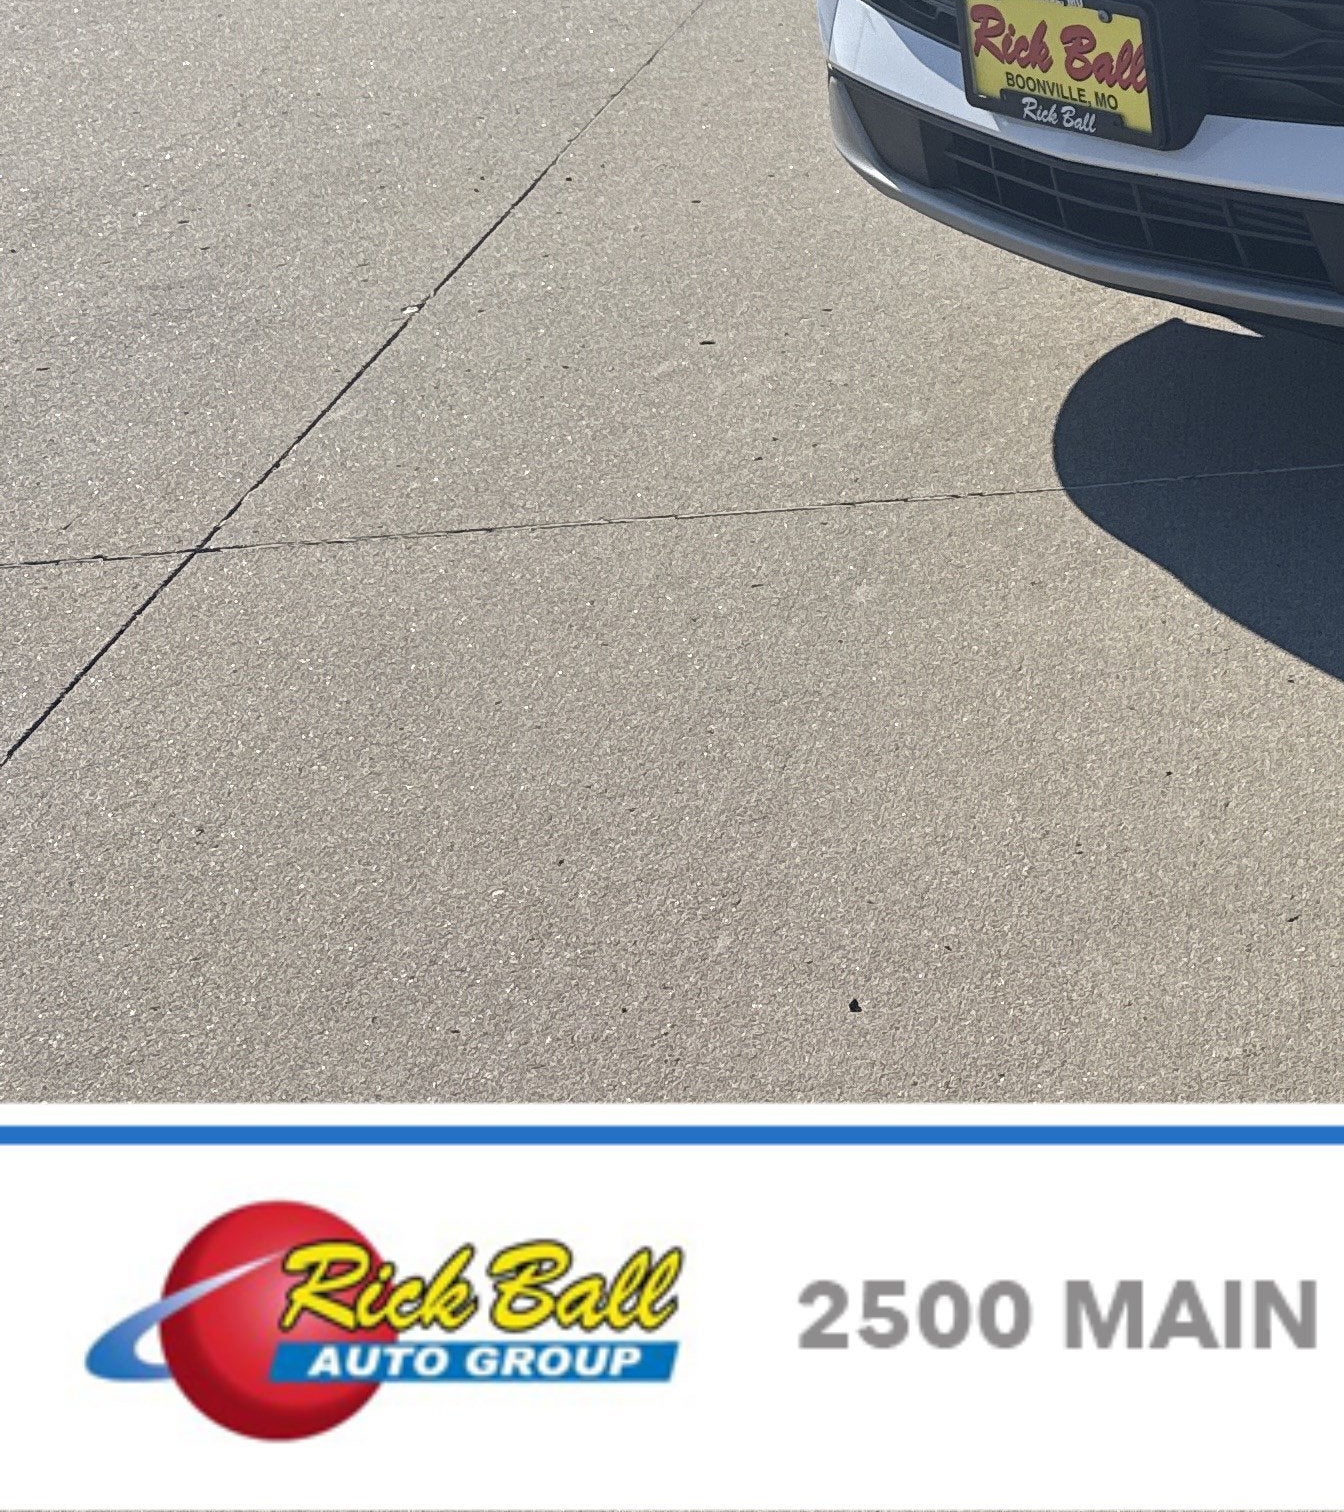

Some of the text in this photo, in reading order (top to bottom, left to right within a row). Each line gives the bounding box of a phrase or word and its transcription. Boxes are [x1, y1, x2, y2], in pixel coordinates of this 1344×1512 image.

[970, 4, 1148, 93] Rick Ball
[1005, 72, 1119, 110] BOONVILLE, MO
[1021, 97, 1097, 133] Rick Ball
